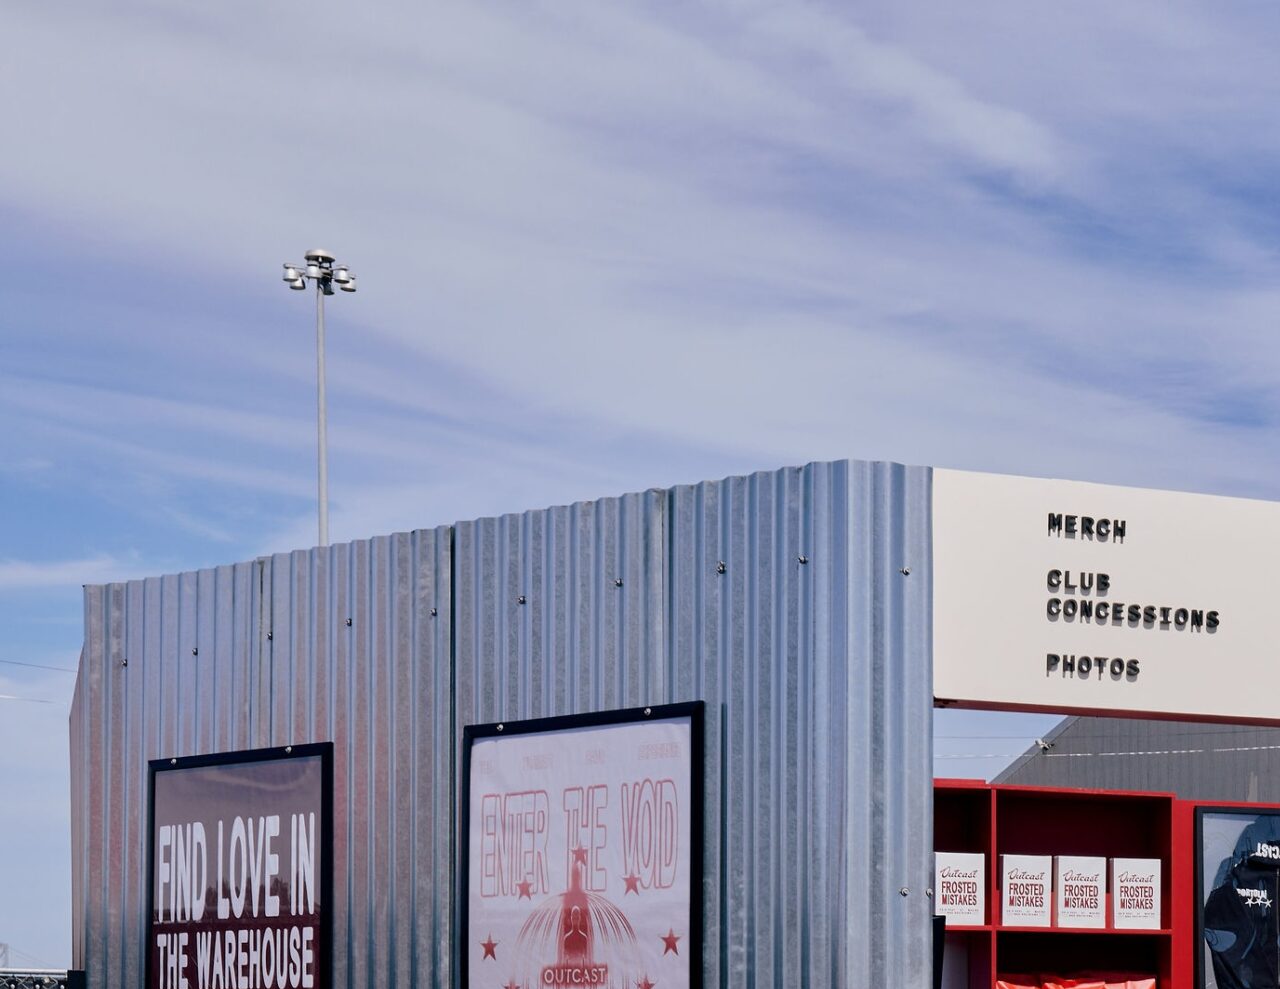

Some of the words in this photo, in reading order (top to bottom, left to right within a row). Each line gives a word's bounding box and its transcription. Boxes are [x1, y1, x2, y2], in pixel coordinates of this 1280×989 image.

[1048, 513, 1126, 540] MERCH
[1047, 569, 1110, 592] CLUB
[1047, 598, 1220, 629] CONCESSIONS
[1047, 653, 1140, 678] PHOTOS
[480, 789, 549, 898] ENTER
[563, 784, 609, 892] THE
[621, 778, 679, 890] VOID
[158, 821, 208, 924] FIND
[217, 815, 280, 920] LOVE
[290, 812, 315, 916] IN
[940, 866, 979, 879] Outcast
[1007, 867, 1046, 881] Outcast
[1062, 869, 1101, 882] Outcast
[1117, 870, 1156, 883] Outcast
[941, 881, 977, 894] FROSTED
[1008, 882, 1045, 896] FROSTED
[1064, 884, 1099, 898] FROSTED
[1119, 885, 1154, 899] FROSTED
[941, 894, 977, 906] MISTAKES
[1008, 896, 1044, 908] MISTAKES
[1064, 897, 1099, 909] MISTAKES
[1119, 898, 1154, 910] MISTAKES
[544, 967, 606, 984] OUTCAST
